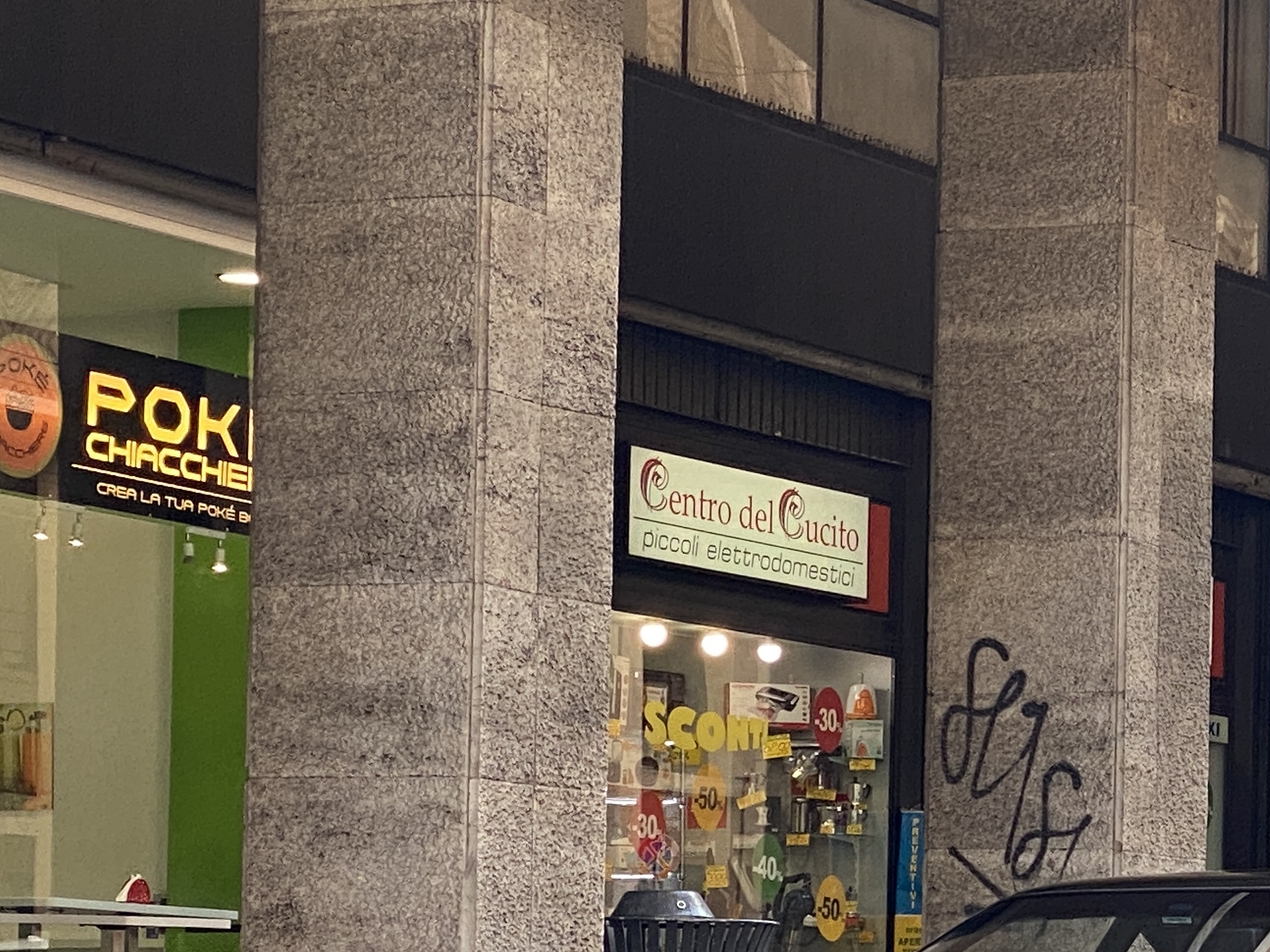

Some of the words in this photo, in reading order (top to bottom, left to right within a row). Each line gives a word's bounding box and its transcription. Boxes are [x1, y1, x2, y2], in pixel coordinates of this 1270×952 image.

[86, 370, 254, 462] POK
[85, 432, 253, 492] CHIACCHIE
[97, 482, 138, 502] CREA
[140, 491, 161, 506] LA
[164, 496, 195, 513] TUA
[198, 504, 237, 521] POKÉ
[239, 511, 251, 523] B
[640, 456, 732, 525] Centro
[739, 496, 775, 534] del
[778, 487, 860, 552] Cucito
[642, 527, 700, 556] piccoli
[706, 541, 856, 588] elettrodomestici
[909, 817, 920, 910] PREVENTIVI
